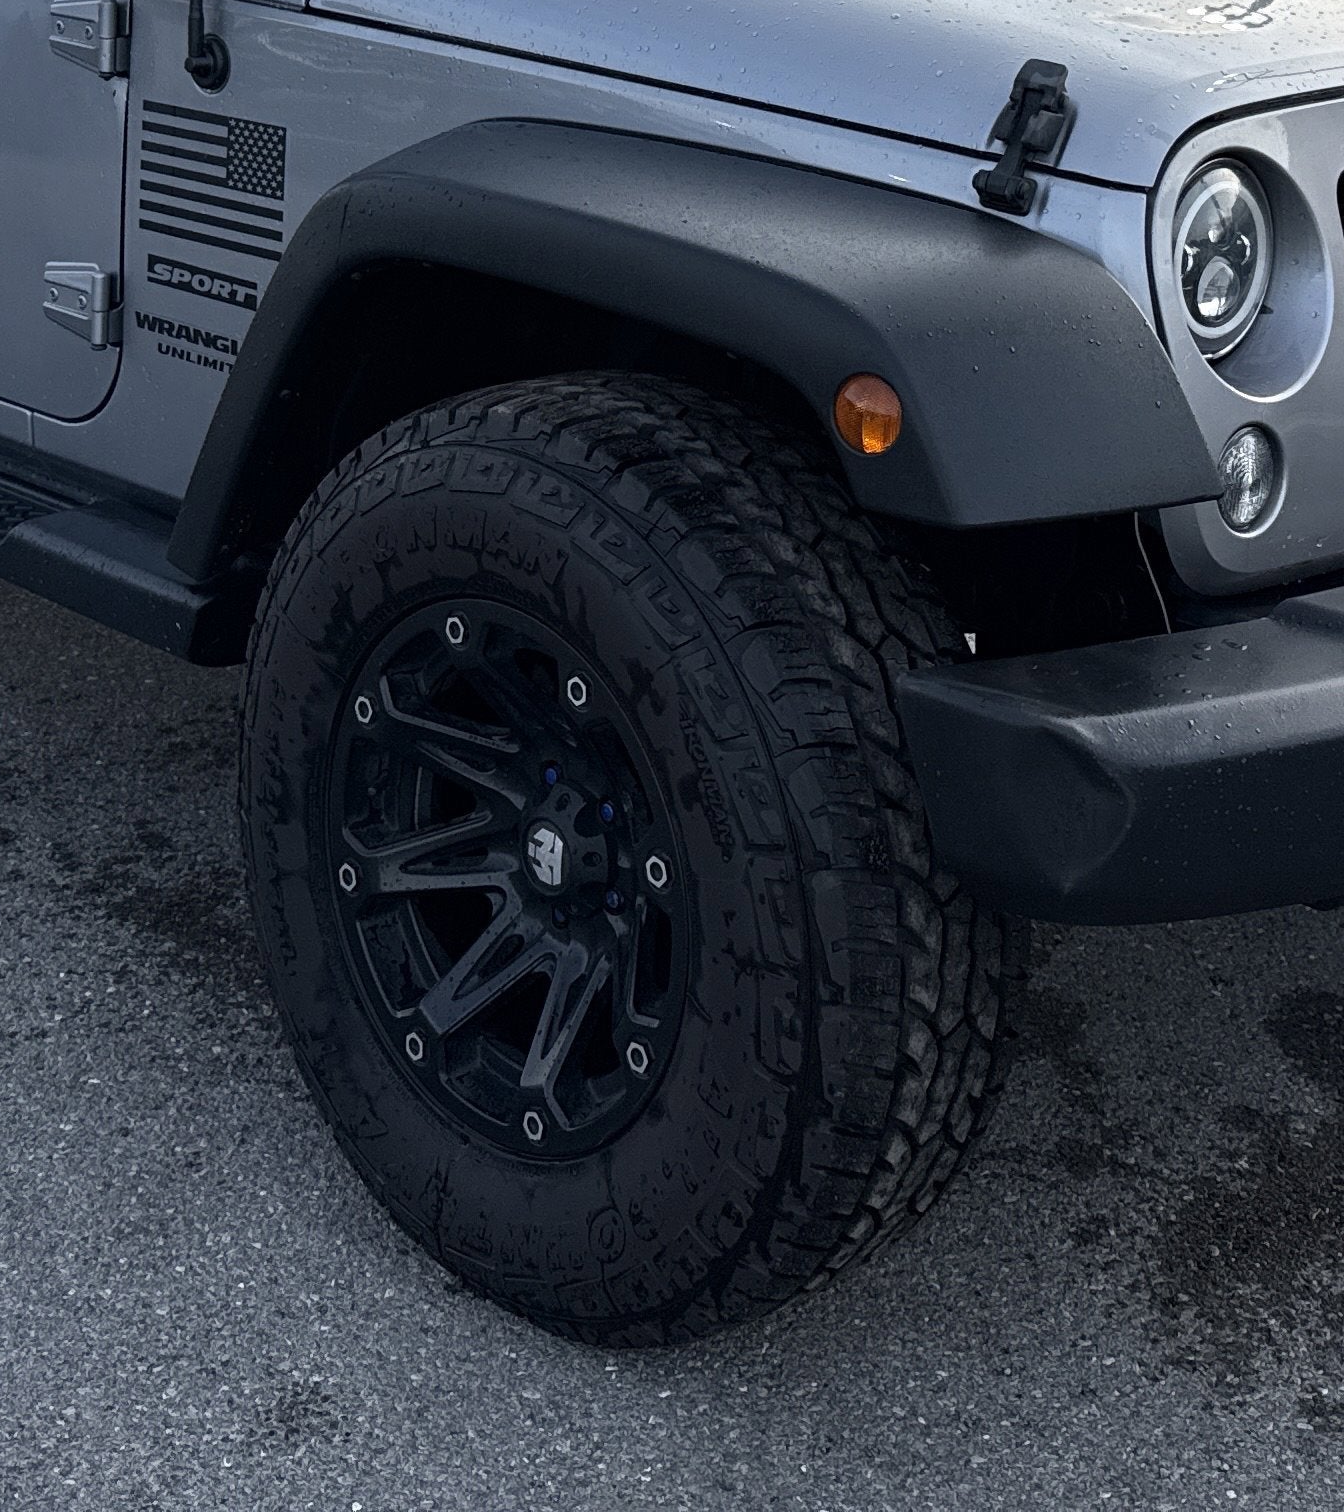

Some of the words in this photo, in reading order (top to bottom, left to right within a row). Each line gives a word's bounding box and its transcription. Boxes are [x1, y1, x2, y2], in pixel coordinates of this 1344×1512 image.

[153, 262, 252, 303] SPORT
[135, 310, 238, 356] WRANGL
[158, 342, 233, 374] UNLIMIT
